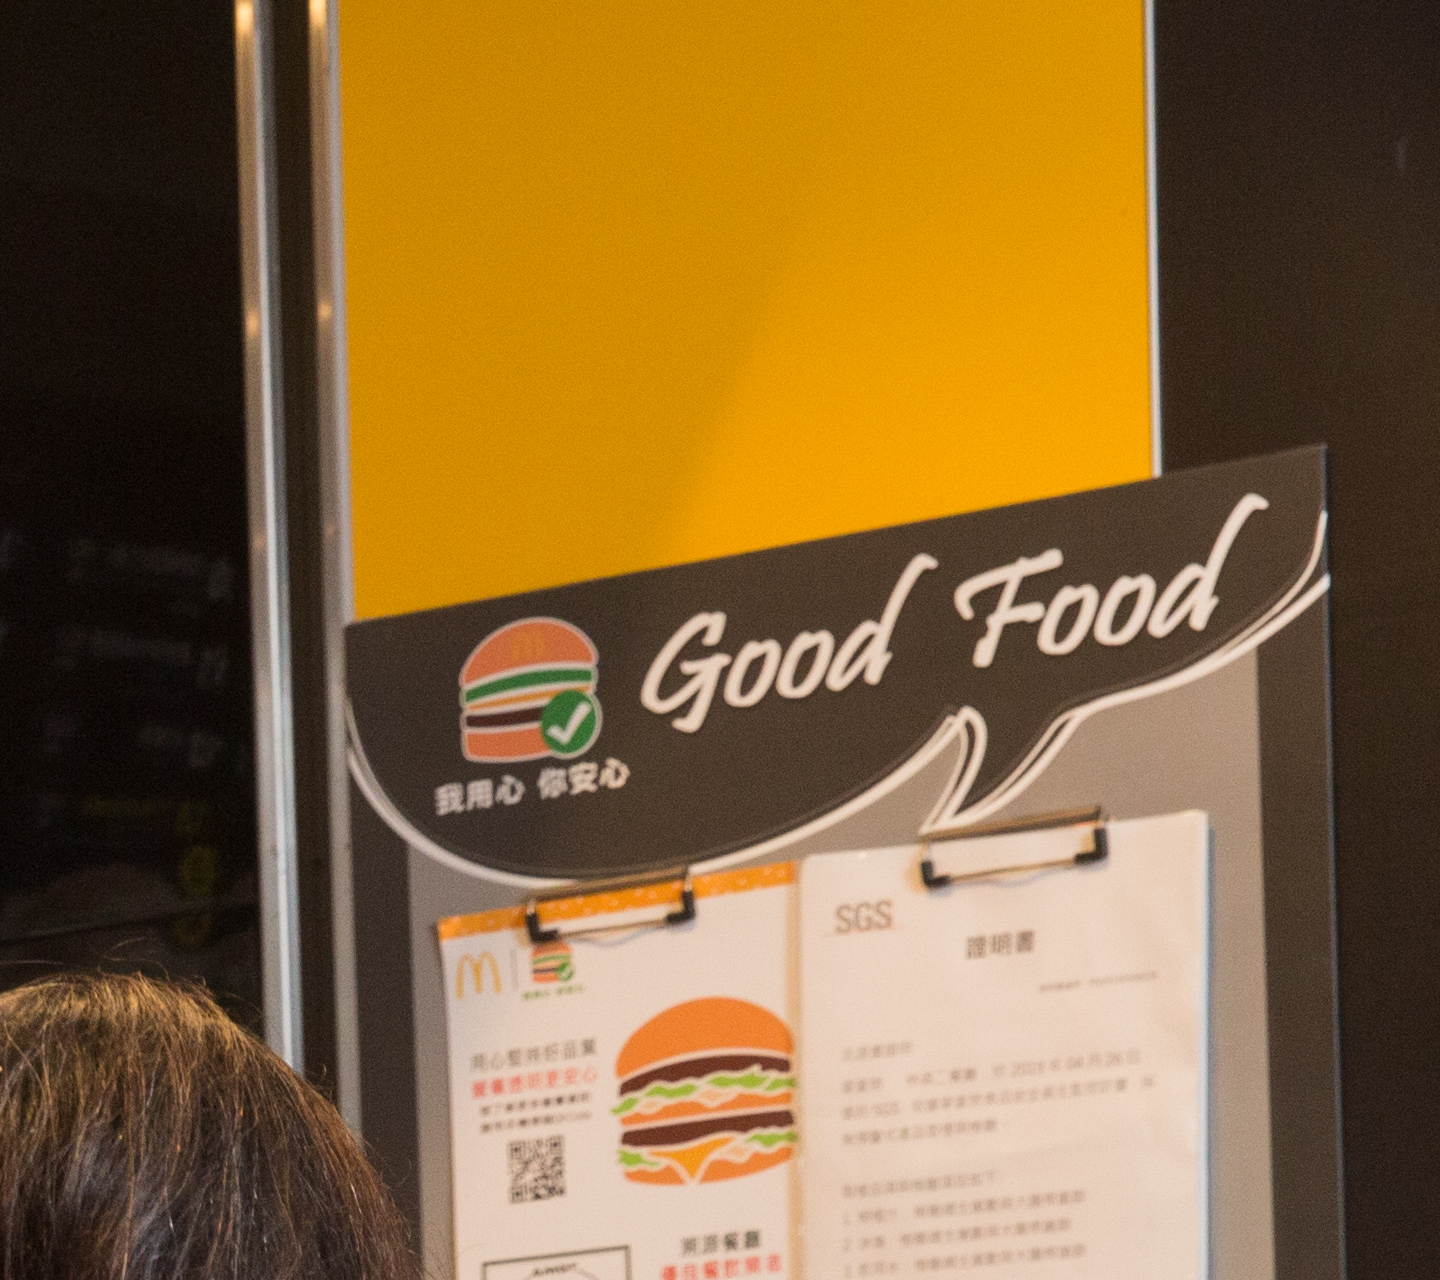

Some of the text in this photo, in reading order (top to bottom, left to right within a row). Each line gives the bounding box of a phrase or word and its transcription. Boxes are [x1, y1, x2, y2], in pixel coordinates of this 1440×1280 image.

[640, 493, 1269, 734] Good Food
[434, 756, 632, 817] 我用心 你安心
[835, 901, 893, 934] SGS
